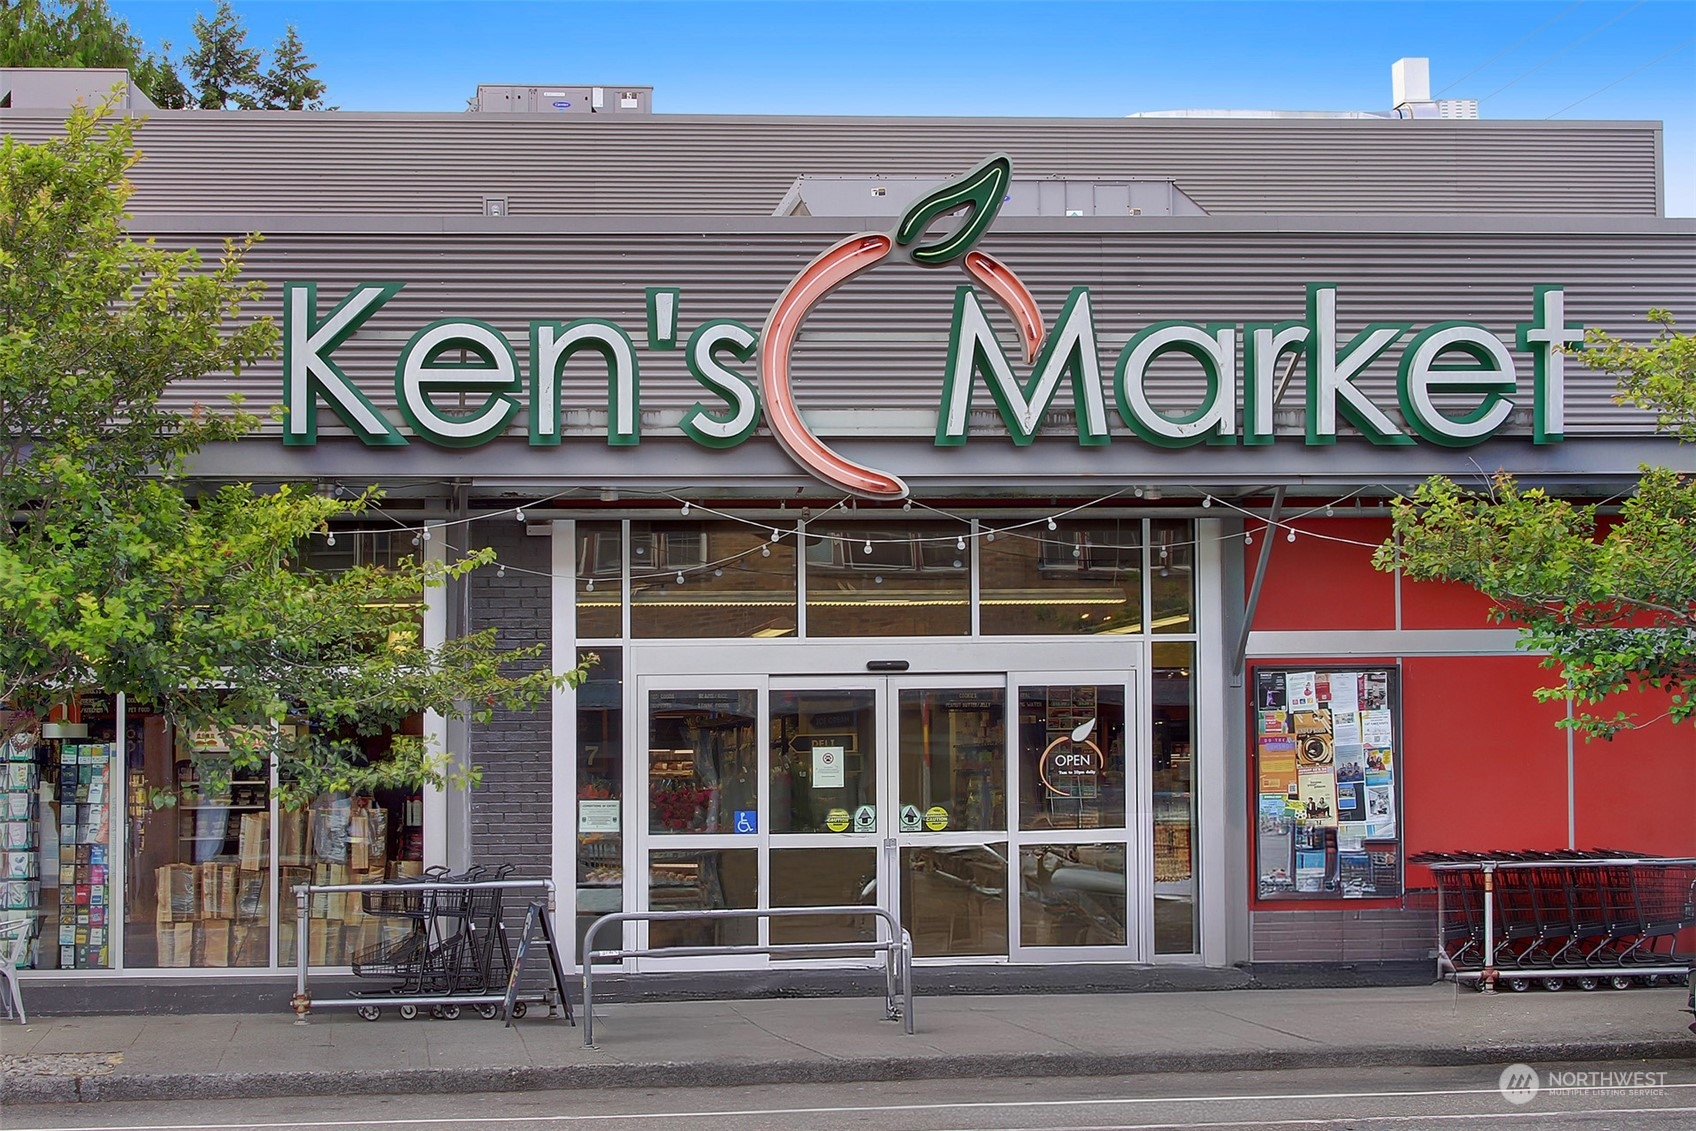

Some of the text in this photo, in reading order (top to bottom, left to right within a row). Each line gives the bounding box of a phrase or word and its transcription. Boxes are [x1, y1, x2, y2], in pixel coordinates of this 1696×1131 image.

[283, 281, 1584, 449] Ken's Market
[584, 745, 599, 766] 7
[1055, 754, 1091, 767] OPEN
